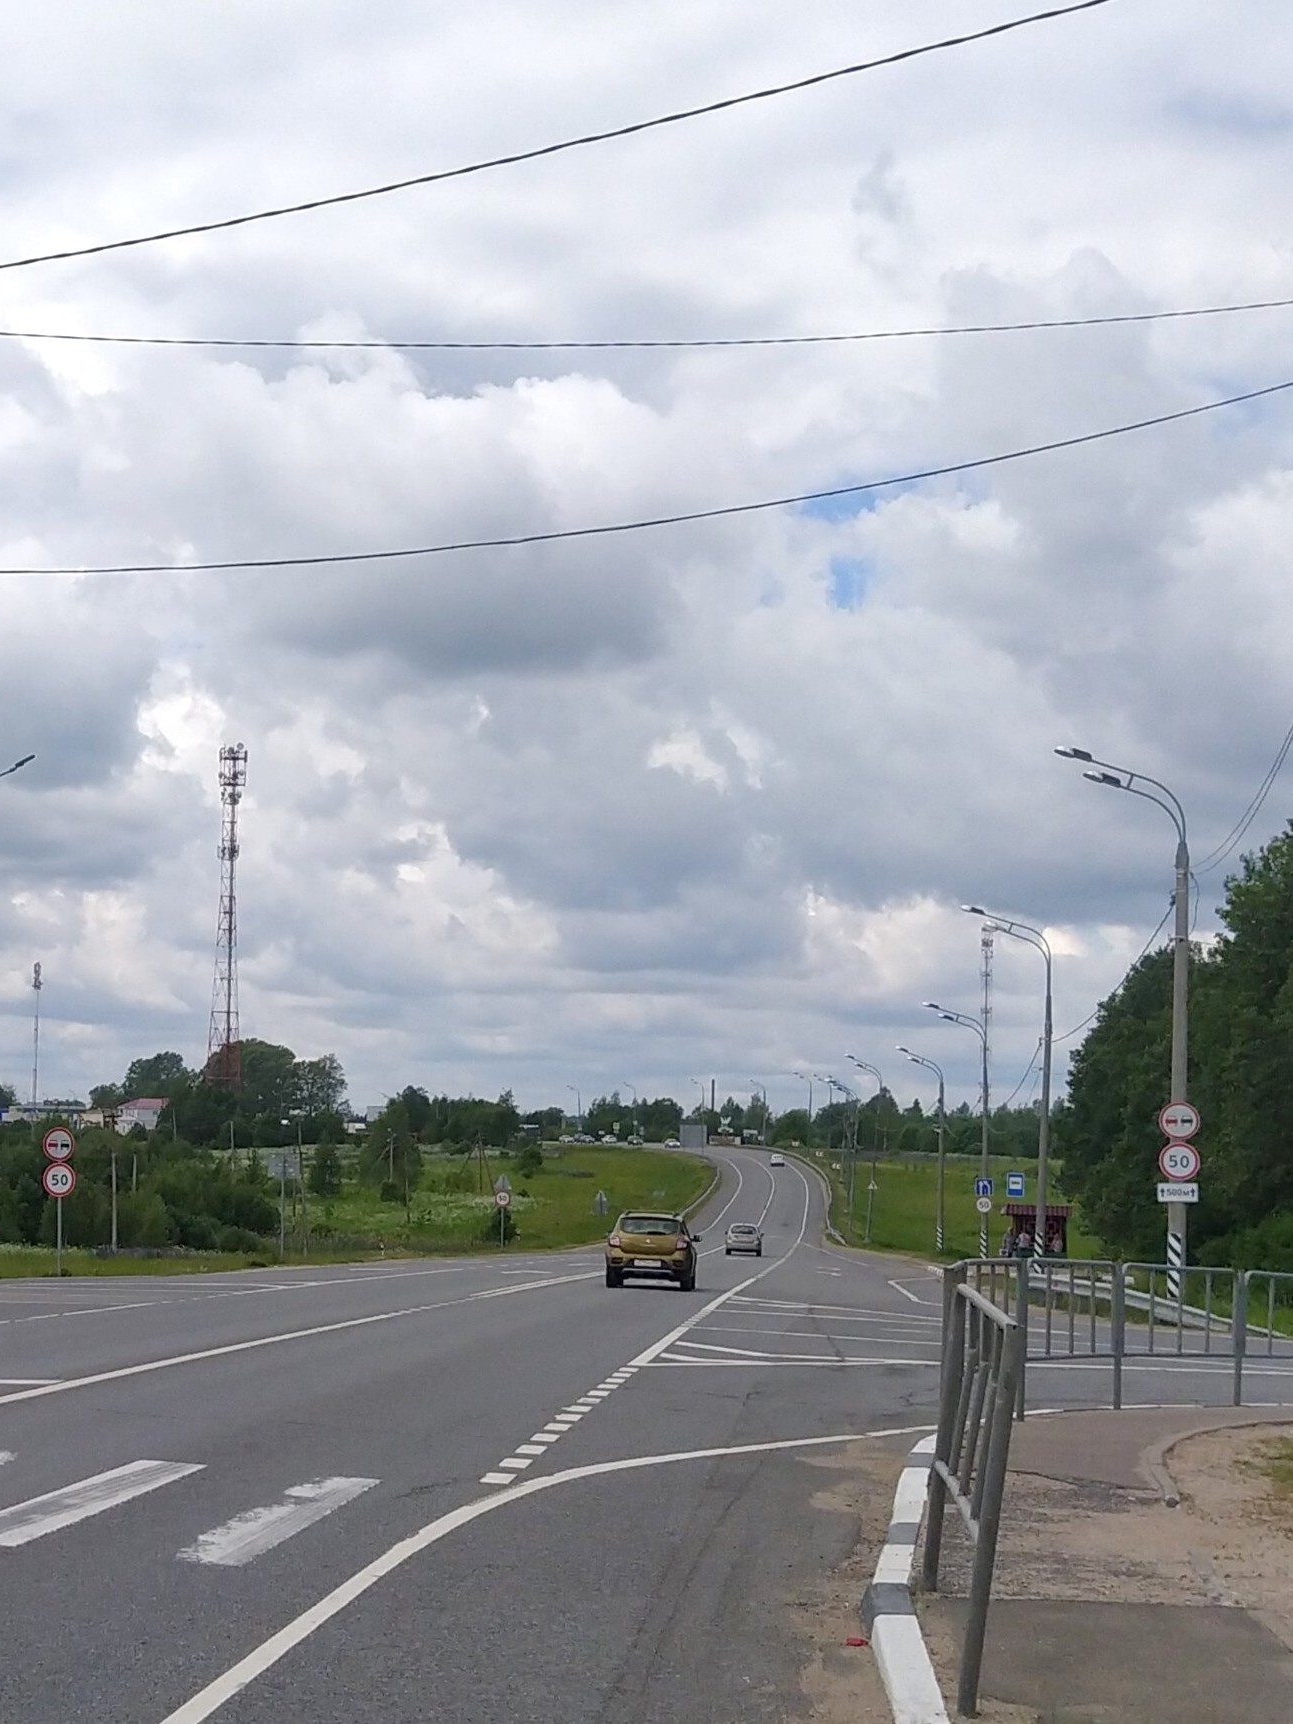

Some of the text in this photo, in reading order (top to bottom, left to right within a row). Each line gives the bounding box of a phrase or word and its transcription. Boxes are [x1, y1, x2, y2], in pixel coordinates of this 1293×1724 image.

[1169, 1155, 1190, 1168] 50
[51, 1174, 69, 1186] 50
[978, 1201, 990, 1209] 50
